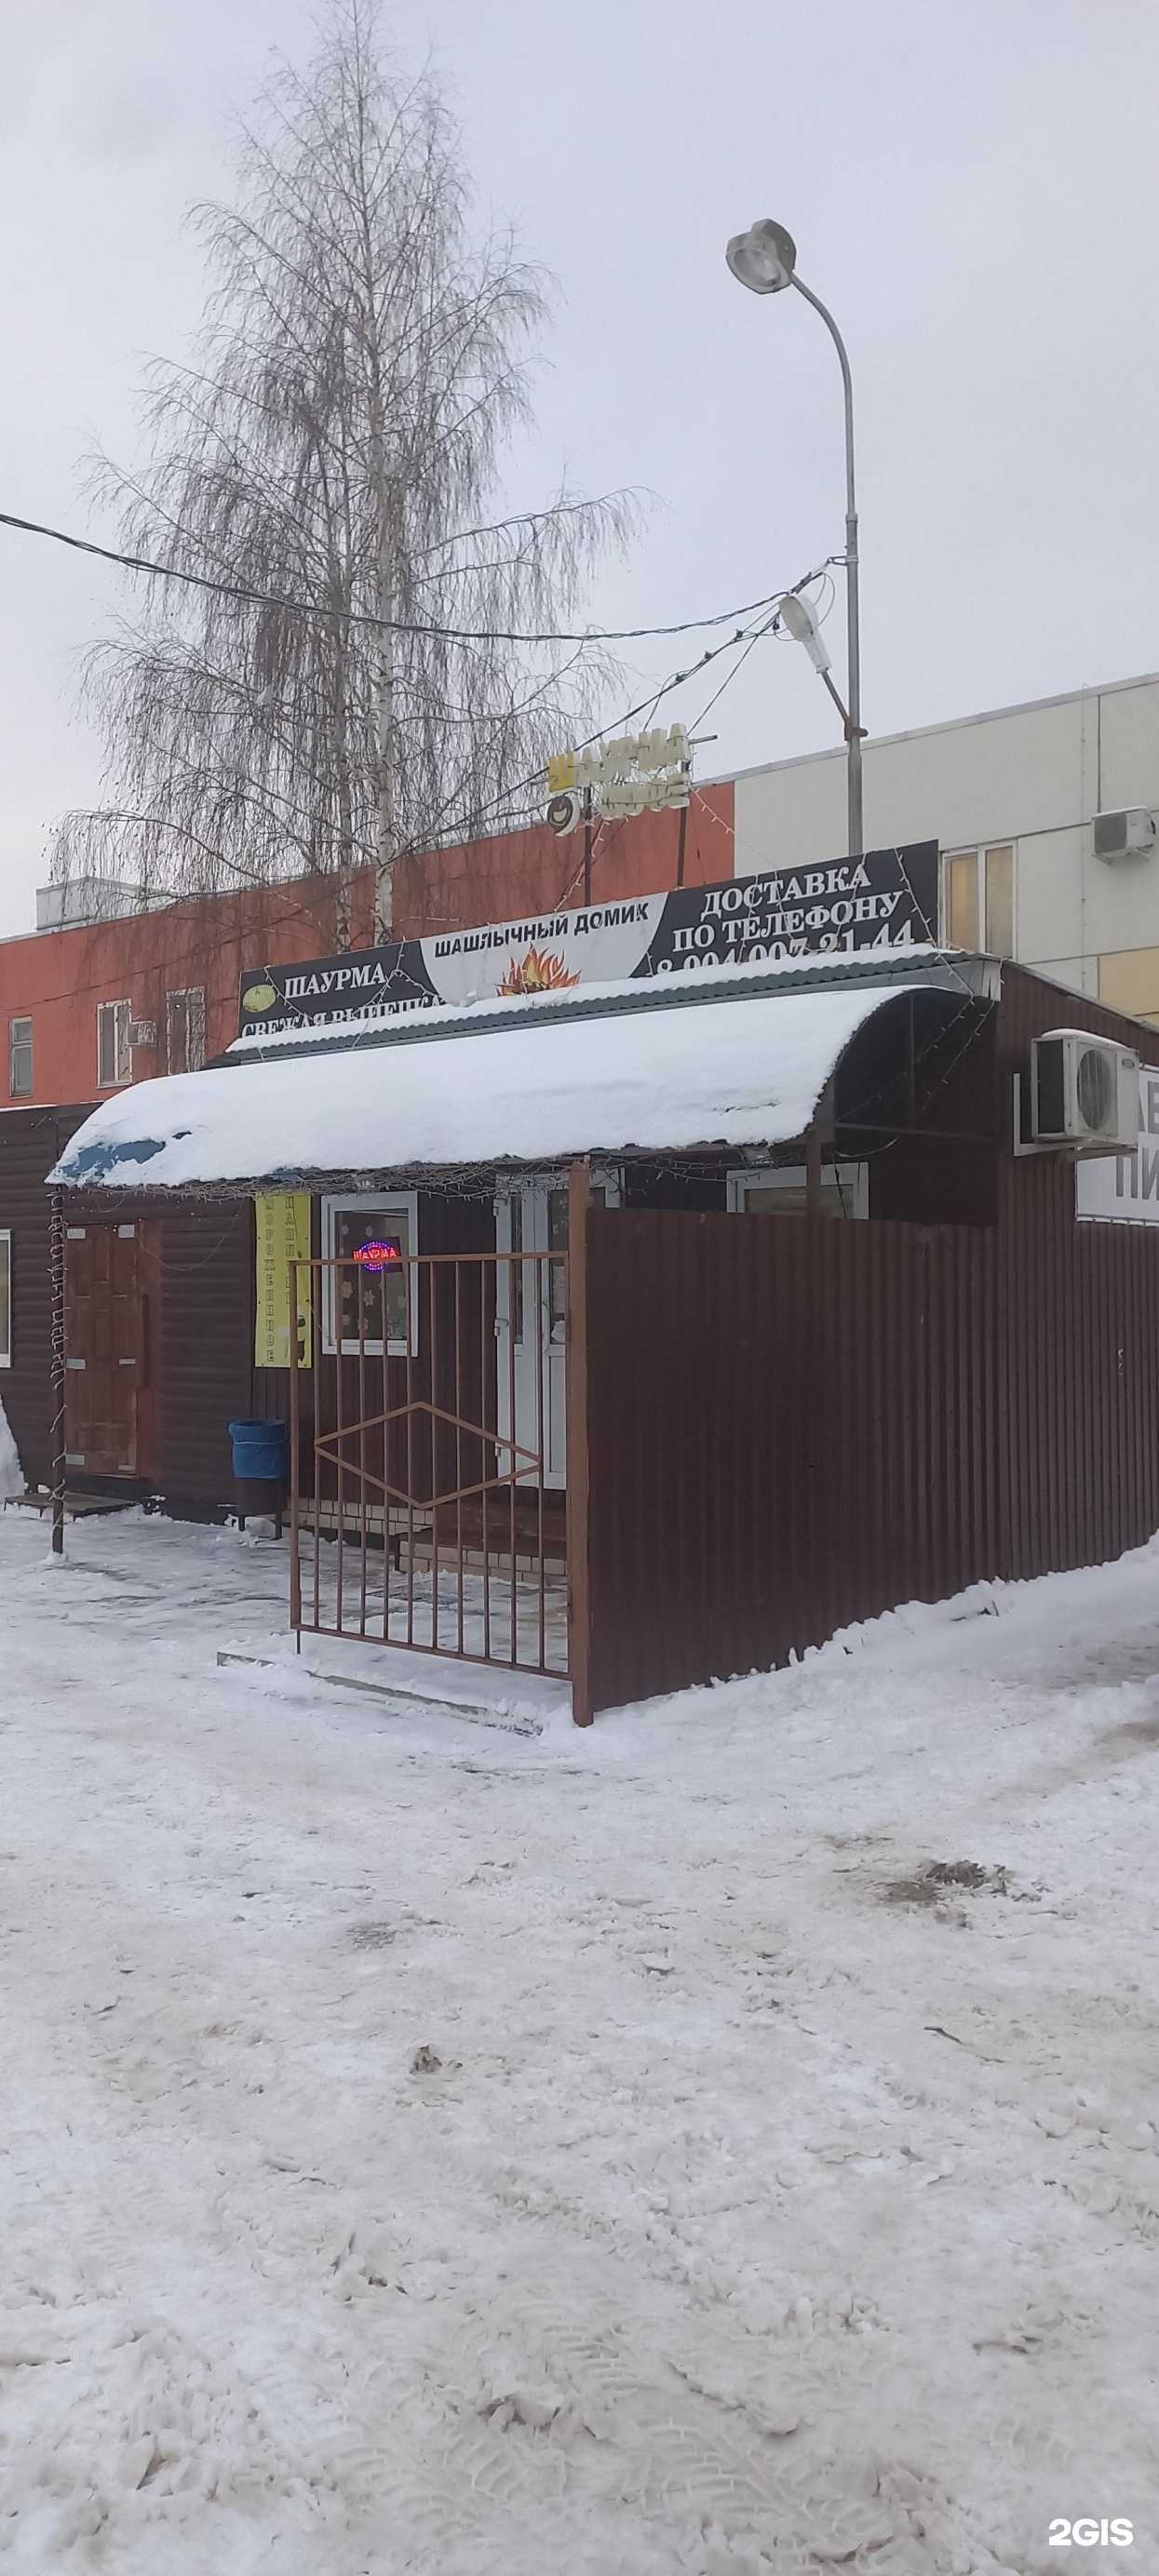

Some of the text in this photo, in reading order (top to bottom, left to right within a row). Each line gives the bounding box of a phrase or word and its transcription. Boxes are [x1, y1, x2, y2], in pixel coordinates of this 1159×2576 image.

[700, 865, 871, 921] ДОСТАВКА
[434, 903, 649, 958] ШАШЛЫЧНЫЙ ДОМИК
[672, 891, 904, 952] ПО ТЕЛЕФОНУ
[284, 962, 386, 999] ШАУРМА
